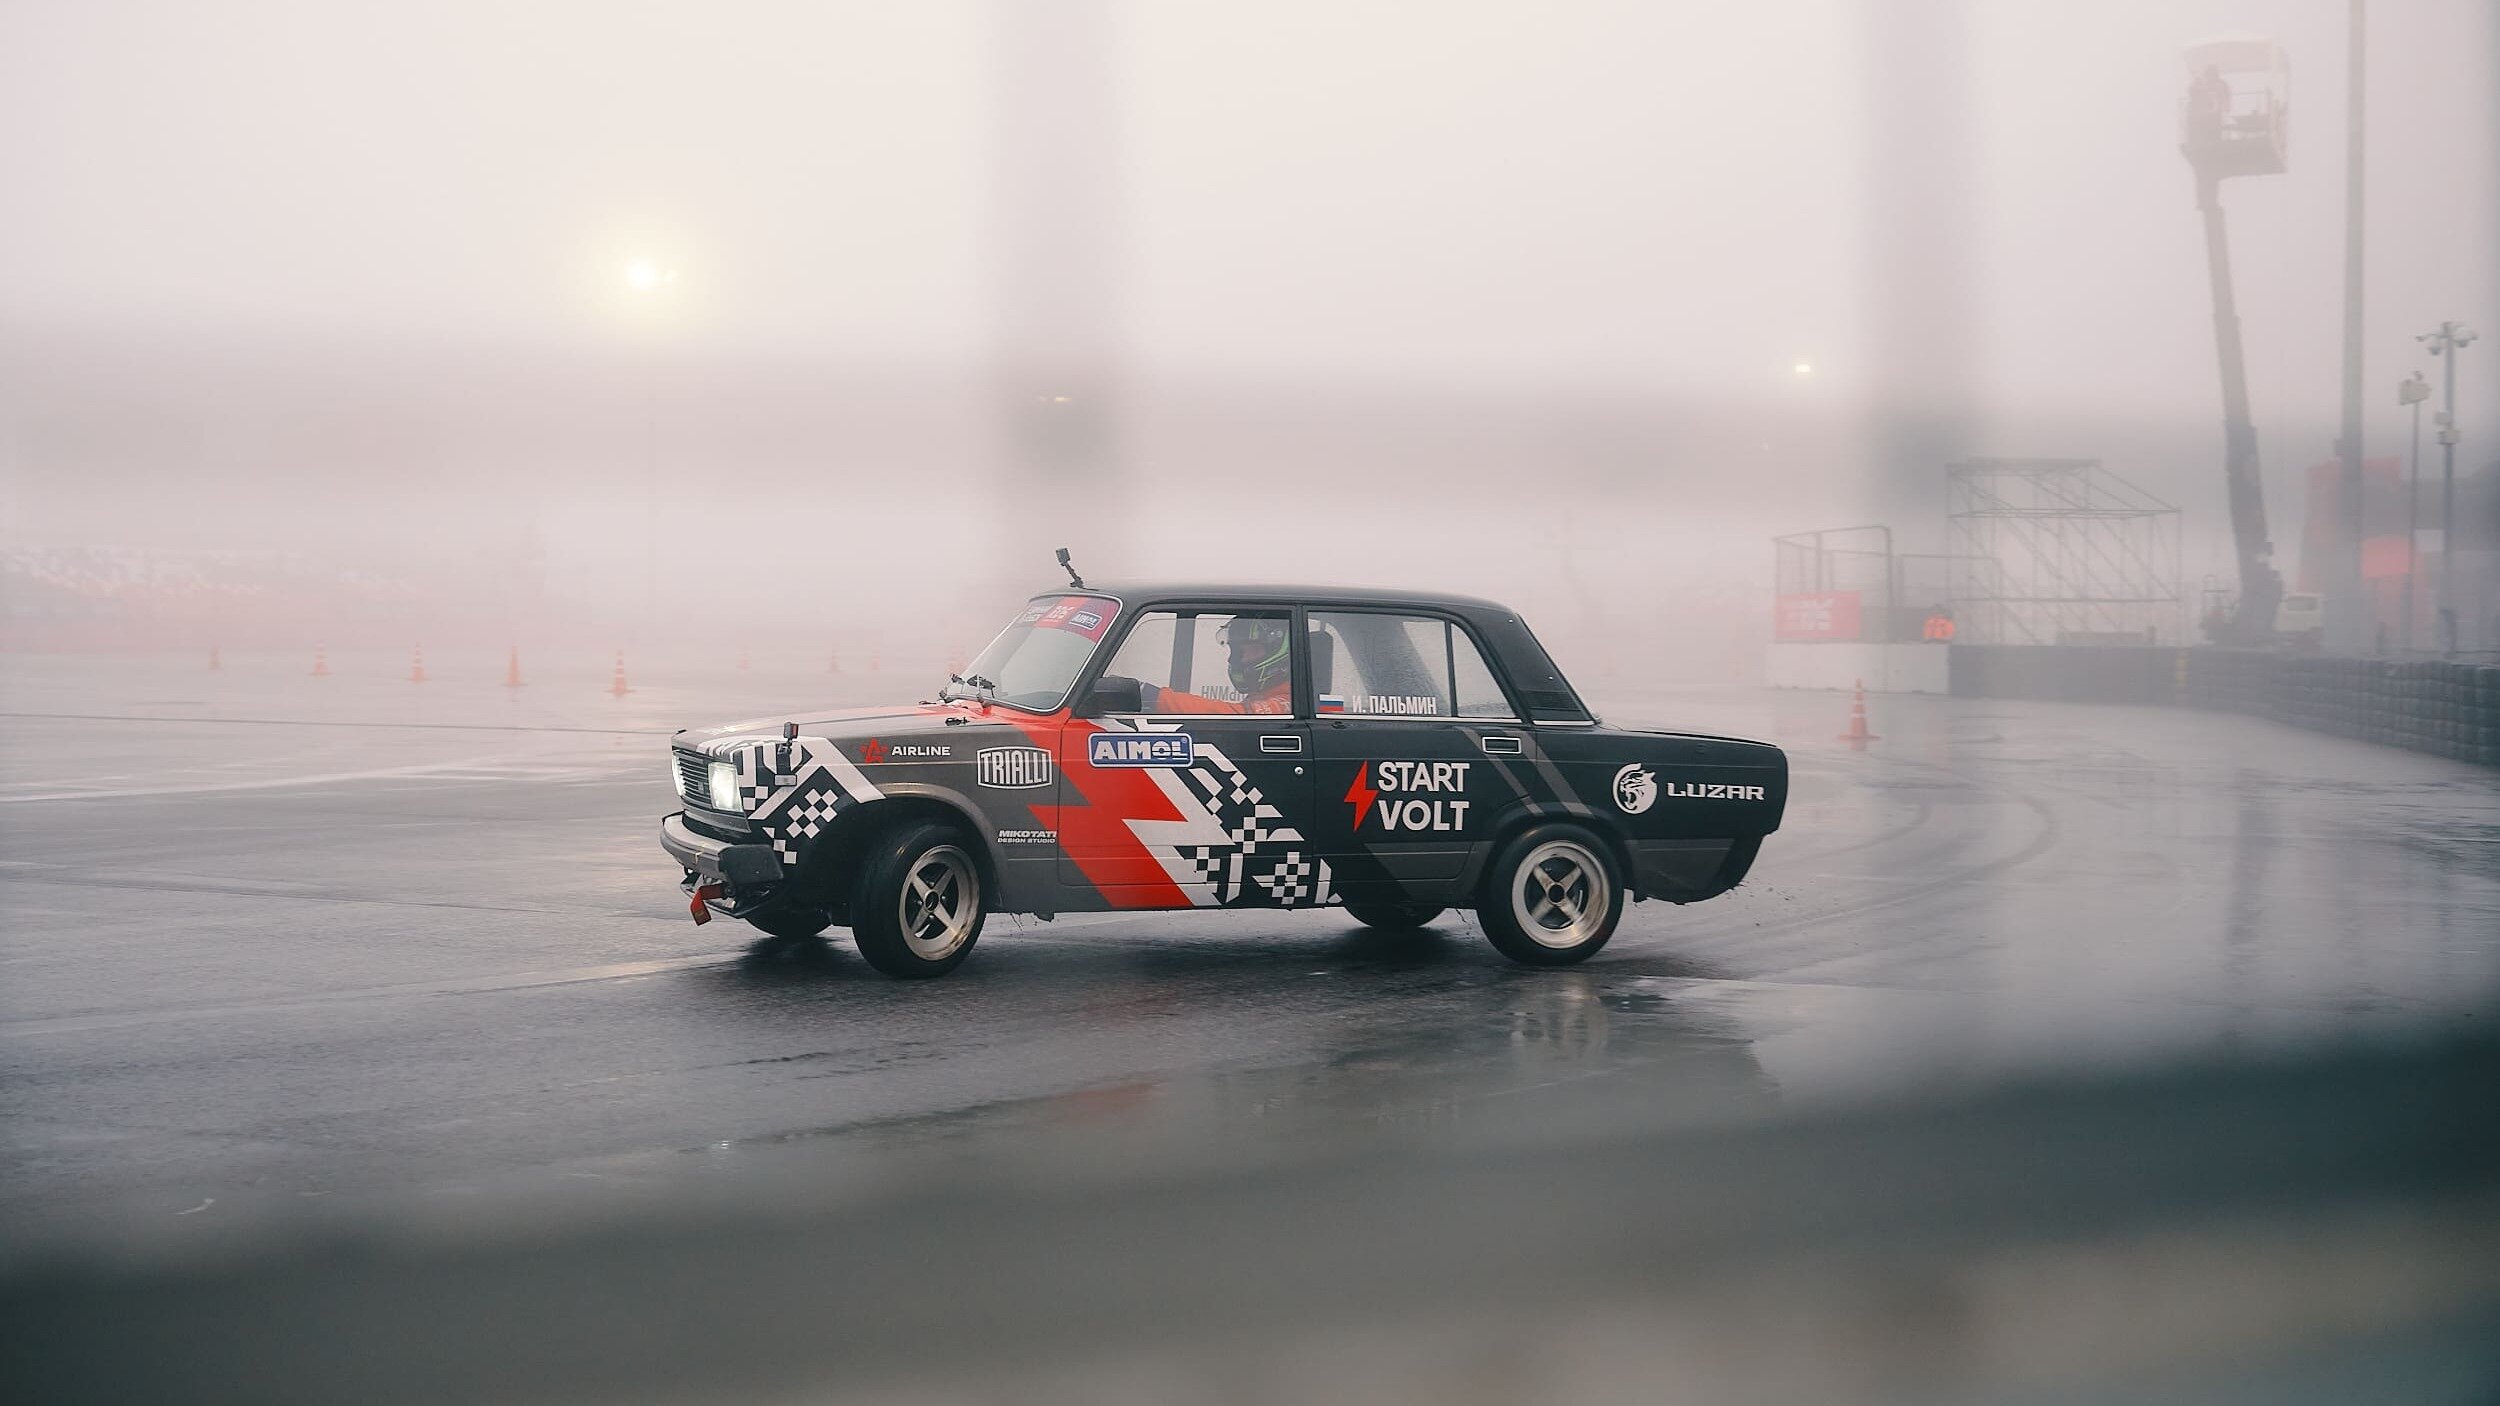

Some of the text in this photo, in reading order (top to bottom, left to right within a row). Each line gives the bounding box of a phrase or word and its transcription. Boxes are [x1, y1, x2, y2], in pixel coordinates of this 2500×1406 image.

[1352, 695, 1437, 714] И. ПАЛЬМИН
[891, 746, 951, 756] AIRLINE
[1093, 741, 1188, 760] AIMOL
[981, 751, 1047, 785] TRIALLI
[1378, 761, 1470, 792] START
[1667, 782, 1765, 800] LUZAR
[1378, 800, 1470, 831] VOLT
[999, 830, 1057, 838] MIKOTATI
